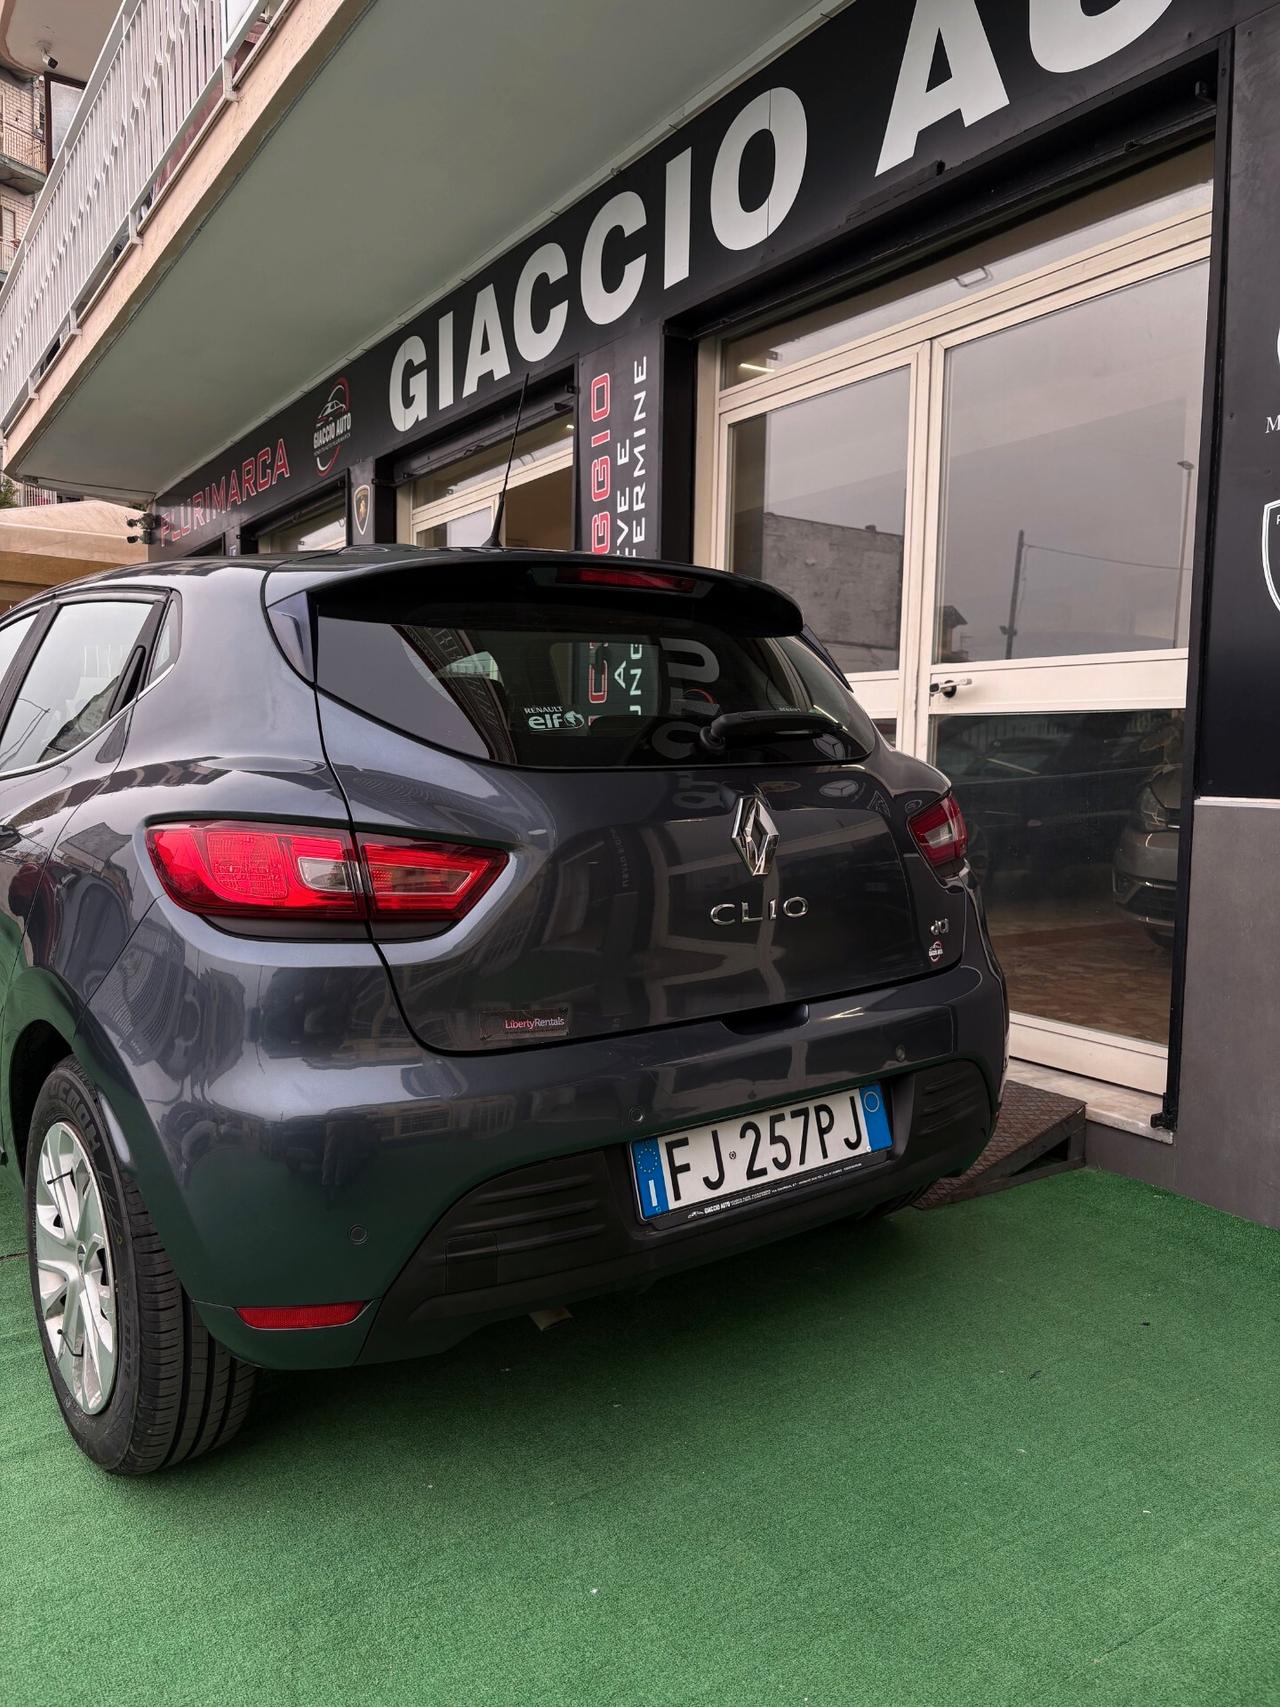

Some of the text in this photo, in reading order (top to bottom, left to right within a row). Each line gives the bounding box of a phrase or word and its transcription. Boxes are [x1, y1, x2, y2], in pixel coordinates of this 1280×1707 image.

[389, 86, 808, 432] GIACCIO
[313, 421, 336, 449] GIACCIO
[336, 412, 352, 437] AUTO
[617, 438, 630, 466] E
[523, 705, 563, 715] RENAULT
[528, 713, 563, 729] elf
[709, 895, 809, 927] CLIO
[505, 1016, 565, 1030] LibertyRentals
